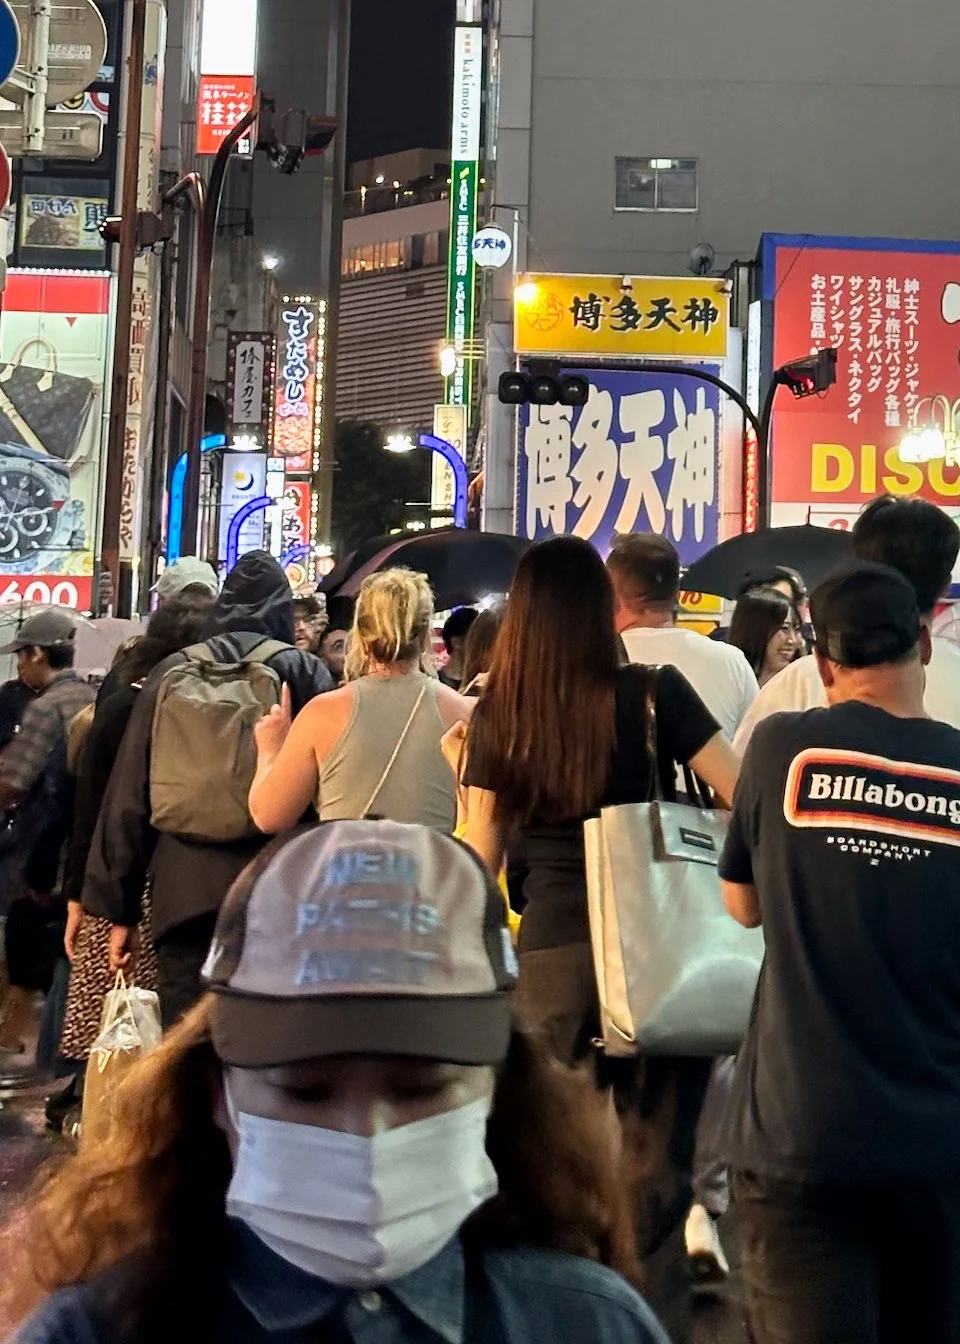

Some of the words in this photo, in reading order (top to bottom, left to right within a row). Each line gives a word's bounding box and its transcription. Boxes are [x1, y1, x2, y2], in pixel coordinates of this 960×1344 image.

[569, 292, 720, 335] 博多天神
[829, 274, 845, 349] ワイシャツ
[847, 275, 864, 425] サングラス・ネクタイ
[866, 276, 883, 392] カジュアルバッグ
[885, 277, 901, 427] 礼服・旅行バッグ各種
[525, 384, 716, 542] 博多天神
[827, 836, 933, 857] BOARDSHORT
[840, 844, 915, 862] COMPANY
